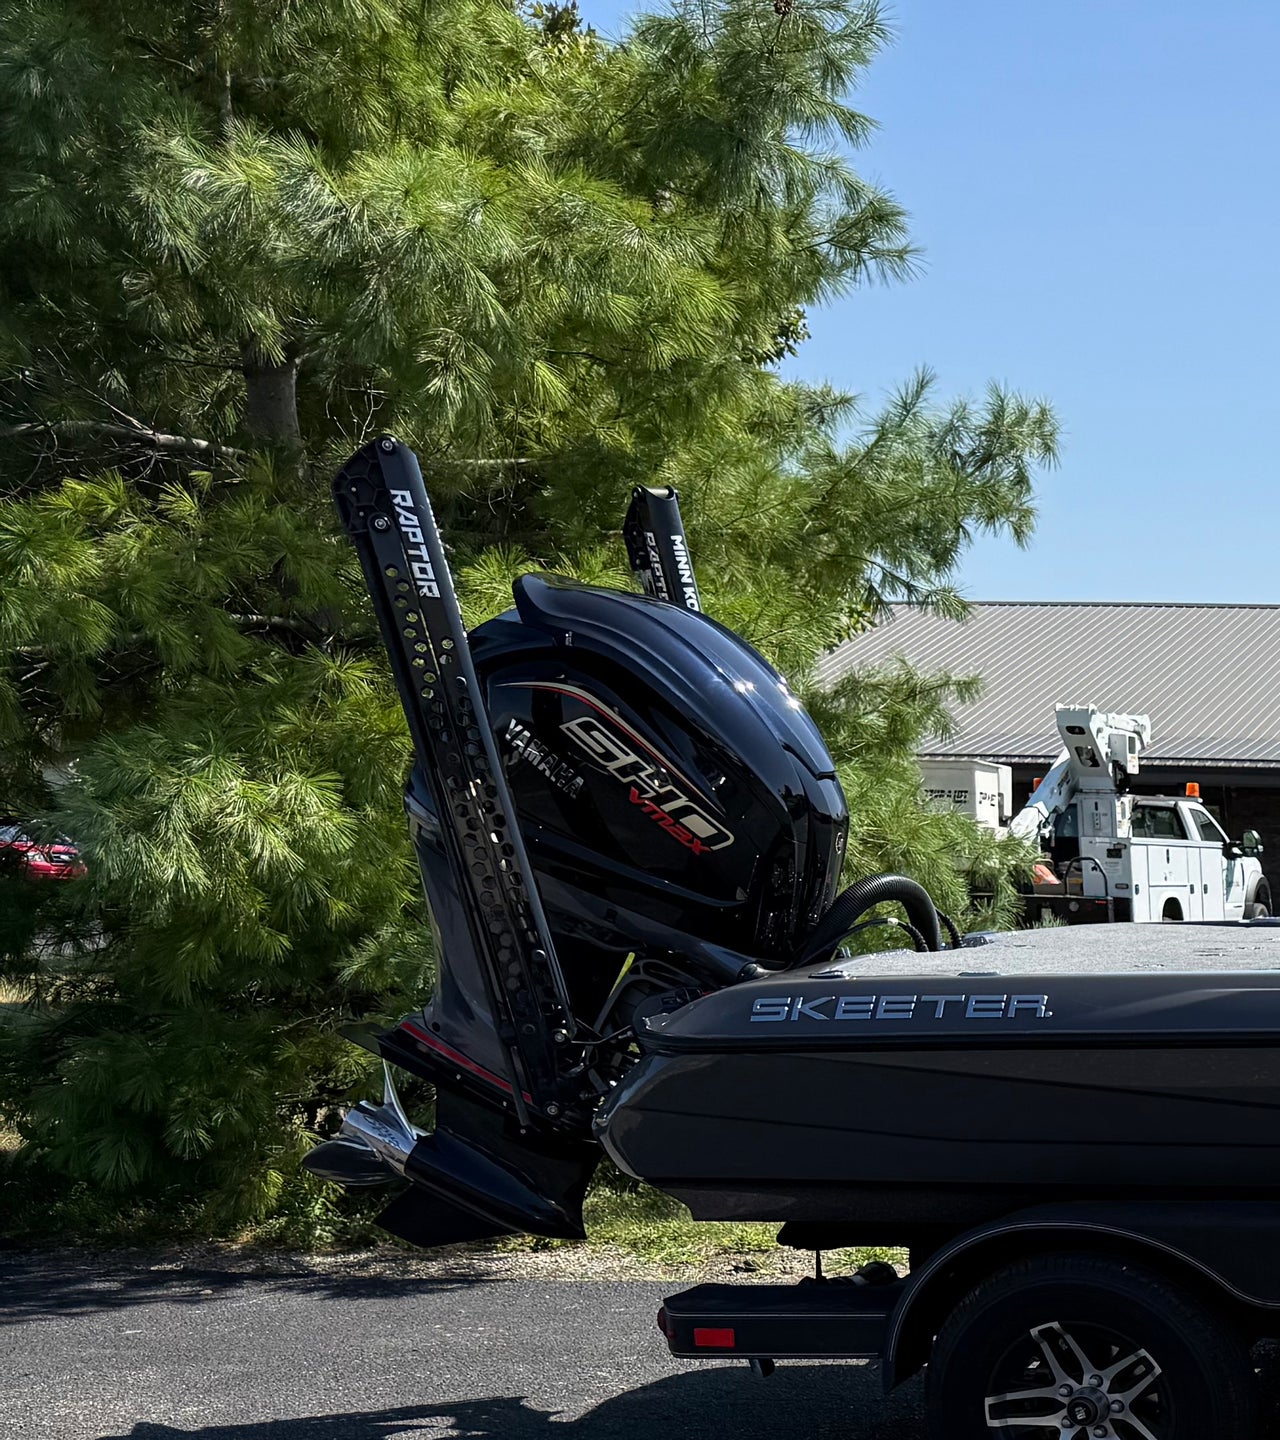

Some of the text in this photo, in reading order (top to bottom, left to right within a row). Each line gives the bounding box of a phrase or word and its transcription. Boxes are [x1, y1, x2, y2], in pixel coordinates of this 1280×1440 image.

[390, 489, 440, 598] RAPTOR
[644, 531, 669, 601] RAPT
[670, 534, 699, 612] MINN KO
[505, 718, 585, 799] YAMAHA
[559, 716, 735, 851] SHO
[750, 994, 1053, 1022] SKEETER
